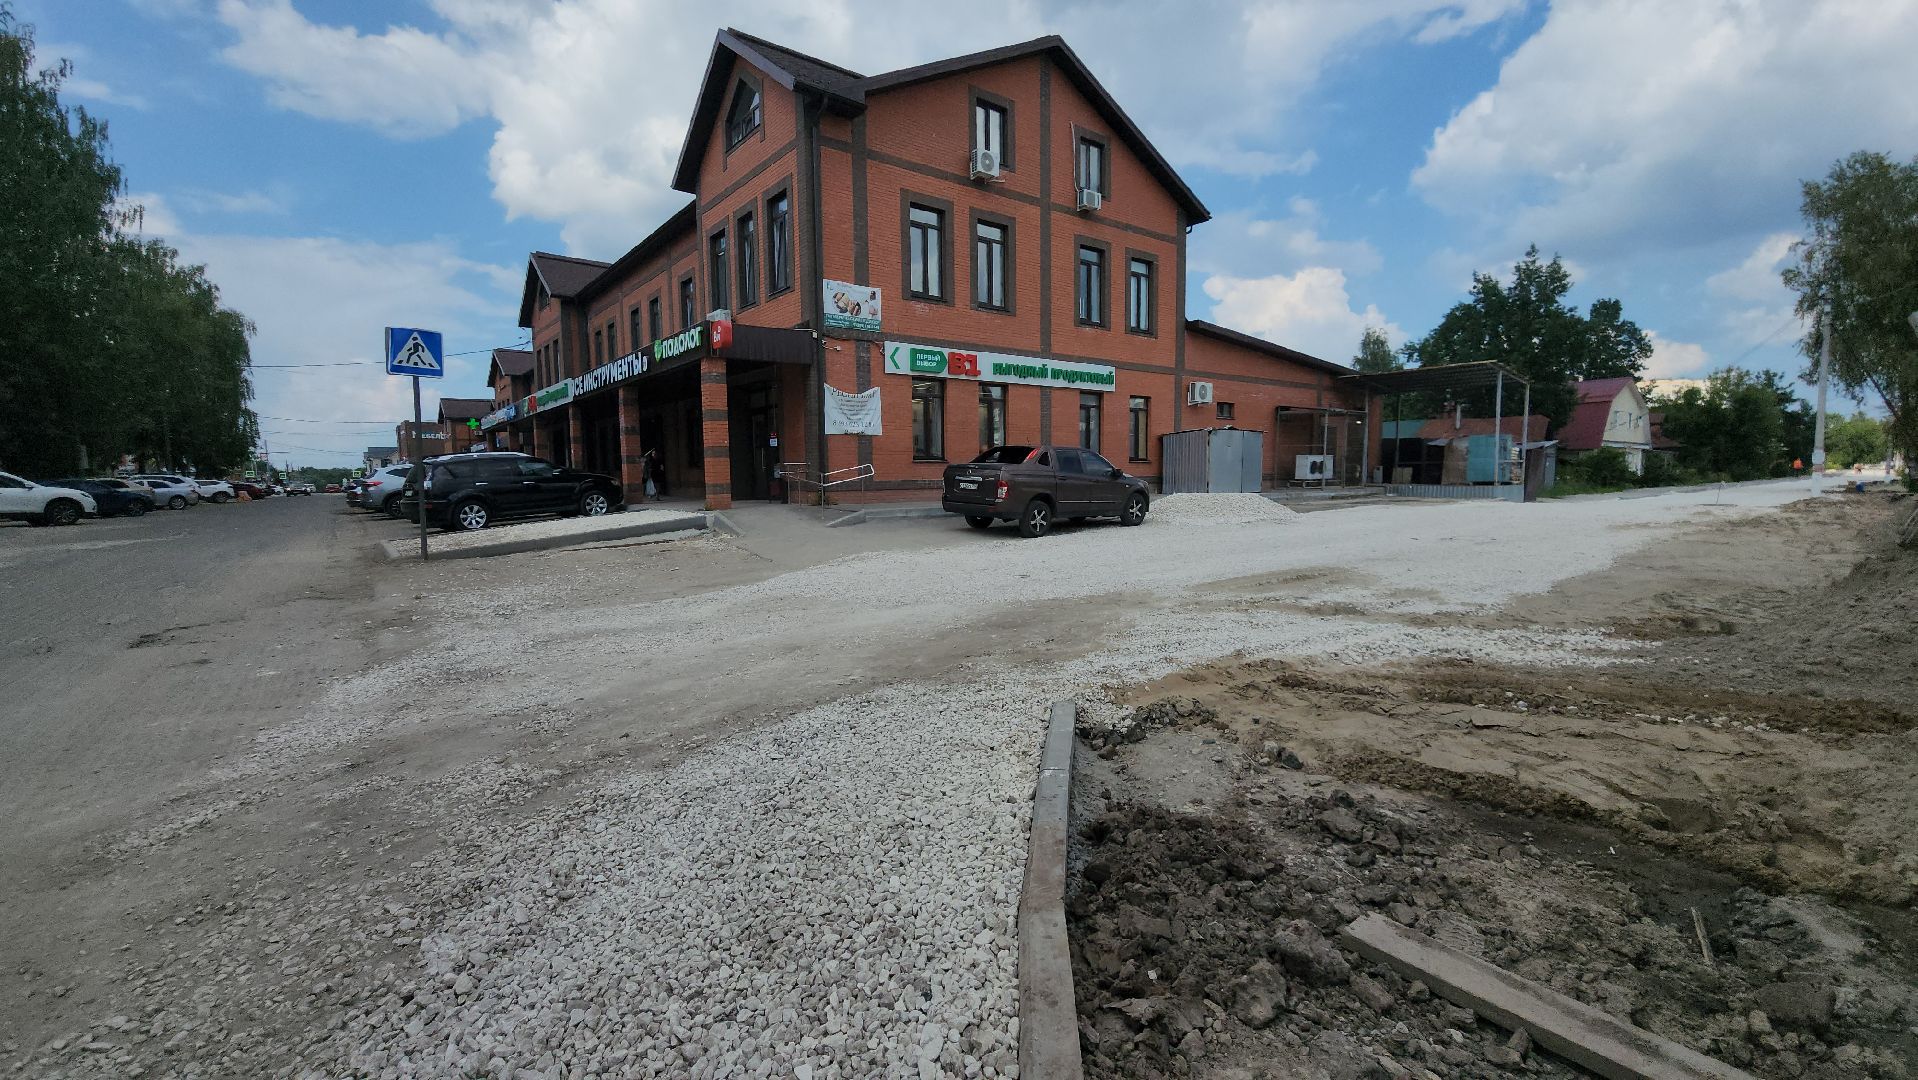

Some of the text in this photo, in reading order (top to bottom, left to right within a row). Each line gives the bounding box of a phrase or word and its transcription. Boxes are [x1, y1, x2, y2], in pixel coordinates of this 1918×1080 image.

[663, 326, 704, 359] ПОДОЛОГ
[916, 353, 941, 362] ПЕРВЫЙ
[992, 362, 1115, 386] ВЫГОДНЫЙ ПРОДУКТОВЫЙ
